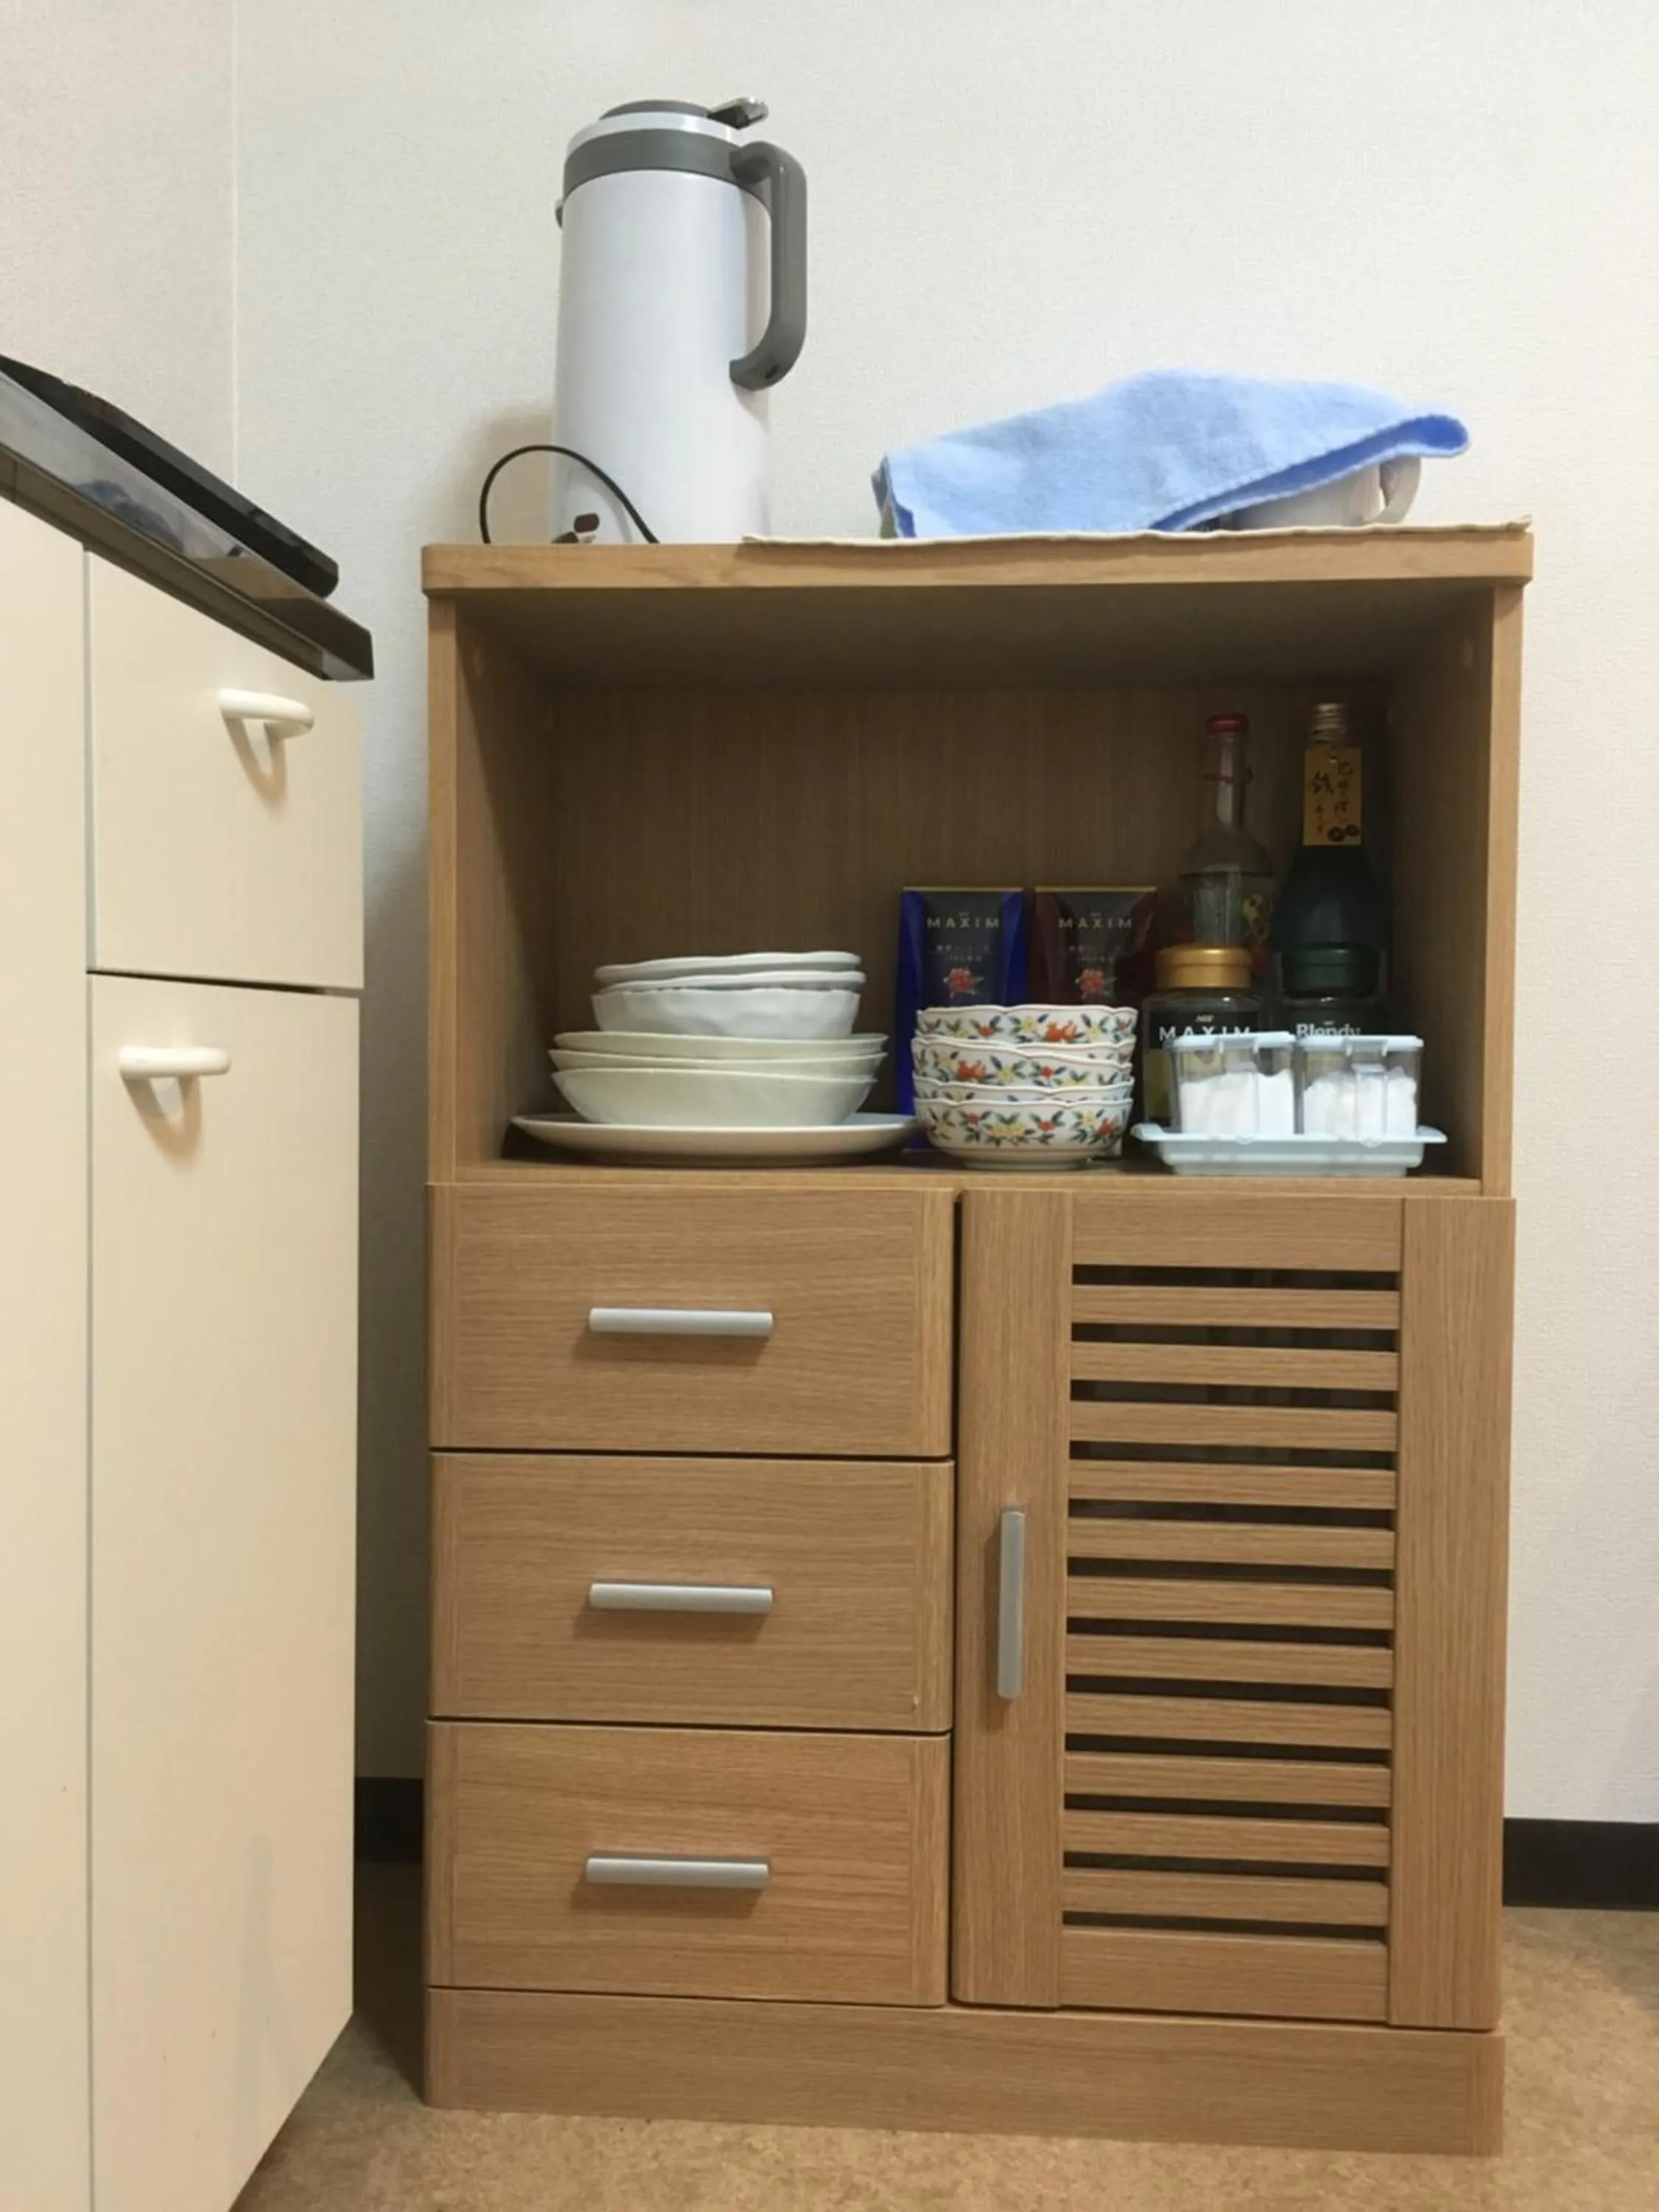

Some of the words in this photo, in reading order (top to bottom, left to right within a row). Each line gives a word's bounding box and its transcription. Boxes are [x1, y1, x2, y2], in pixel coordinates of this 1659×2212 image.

[926, 917, 1000, 929] MAXIM
[1058, 917, 1133, 929] MAXIM
[1158, 1026, 1251, 1041] MAXIM
